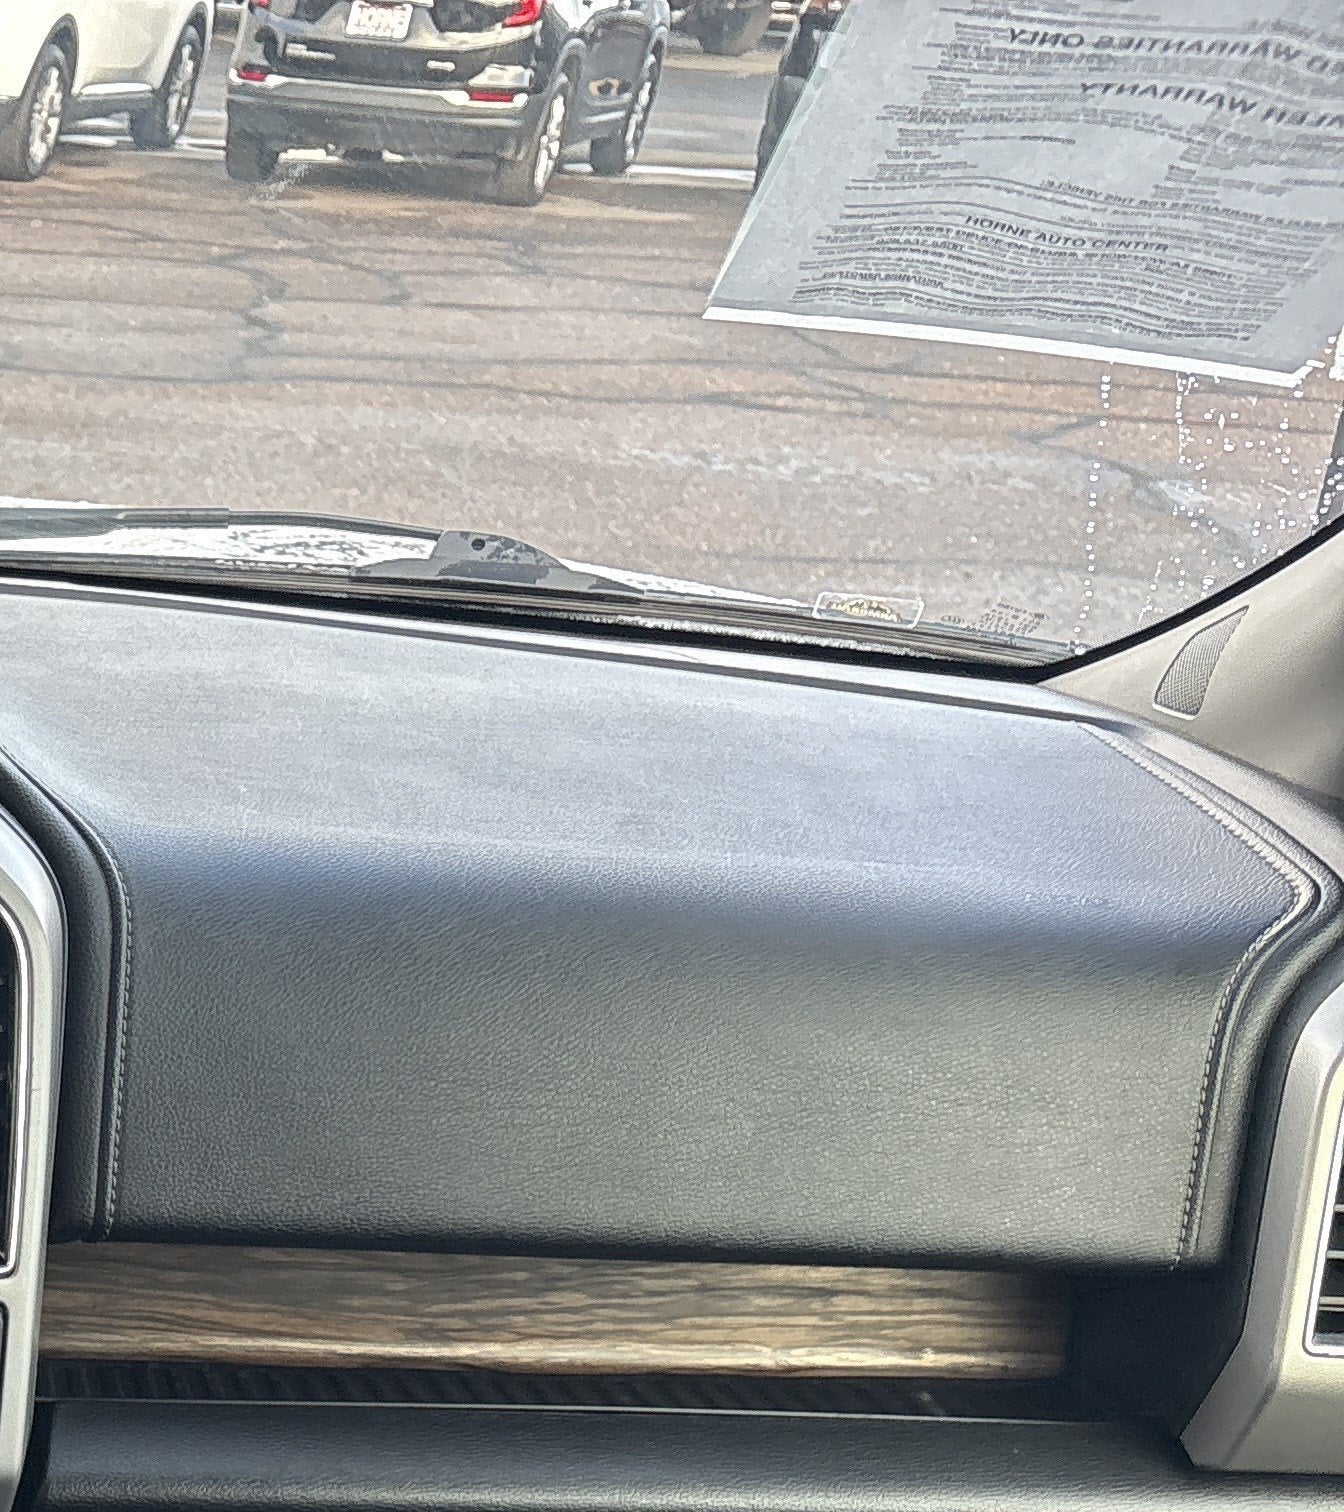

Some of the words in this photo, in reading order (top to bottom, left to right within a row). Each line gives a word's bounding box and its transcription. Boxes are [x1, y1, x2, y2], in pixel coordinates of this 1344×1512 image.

[965, 215, 1032, 238] HORNE
[1035, 232, 1086, 249] AUTO
[1091, 238, 1169, 252] CENTER
